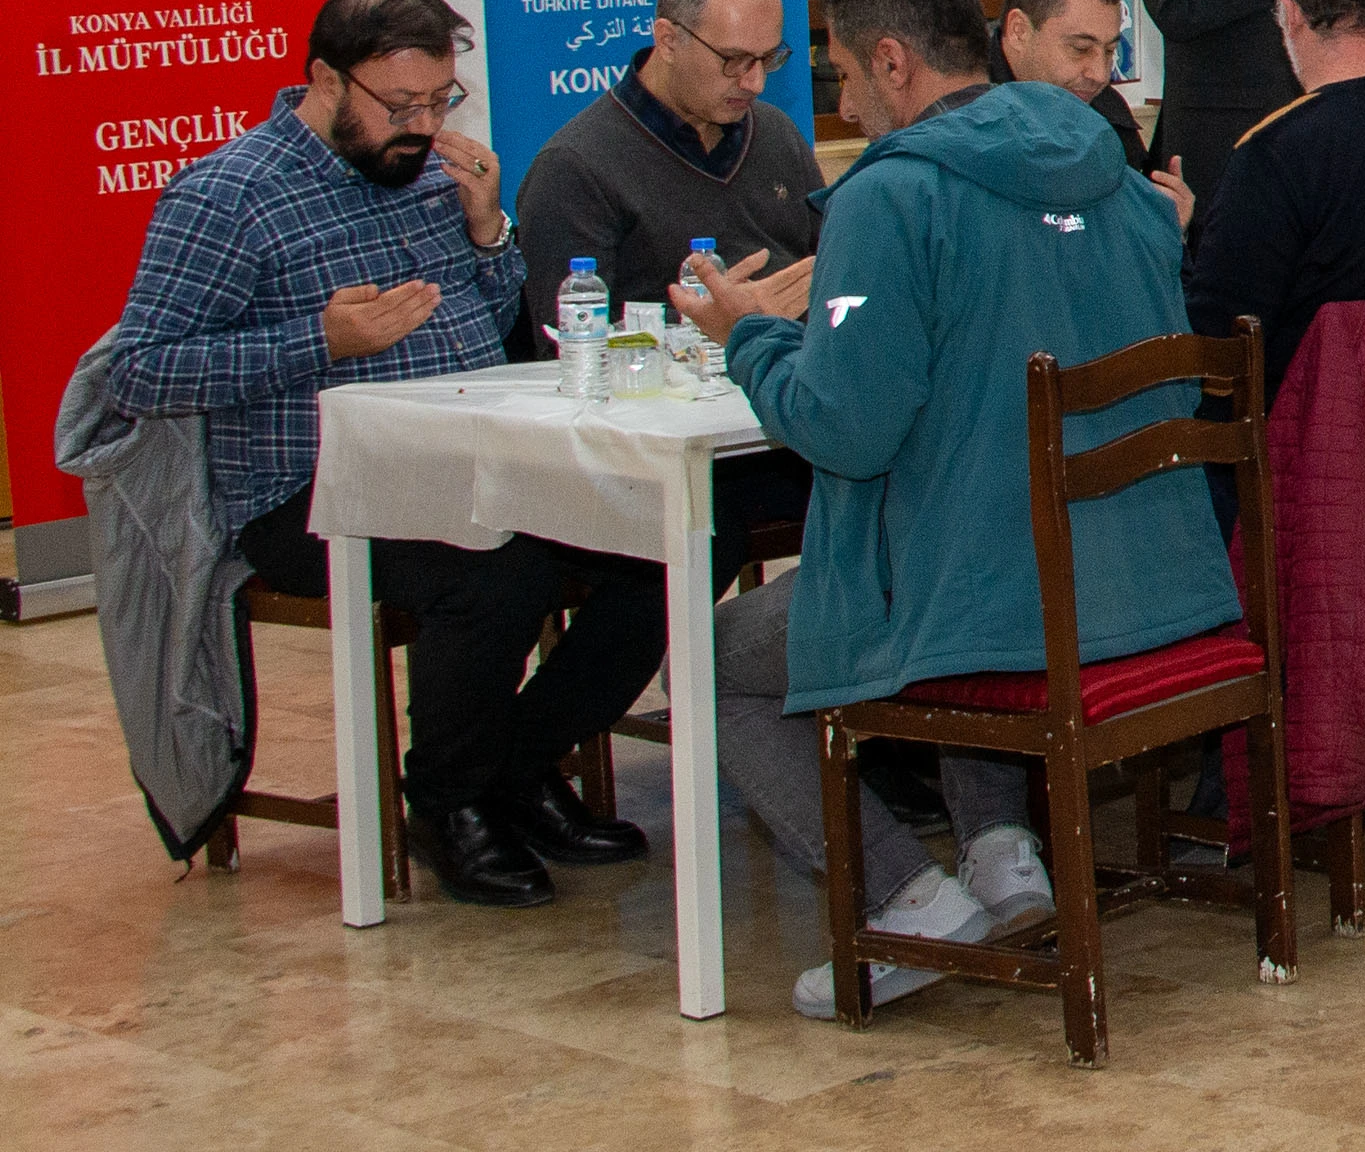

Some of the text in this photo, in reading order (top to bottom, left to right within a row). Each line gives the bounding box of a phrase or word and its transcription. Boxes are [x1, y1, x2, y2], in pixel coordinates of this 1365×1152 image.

[70, 0, 255, 36] KONYA VALİLİĞİ
[35, 26, 289, 76] İL MÜFTÜLÜĞÜ
[95, 105, 249, 153] GENÇLİK
